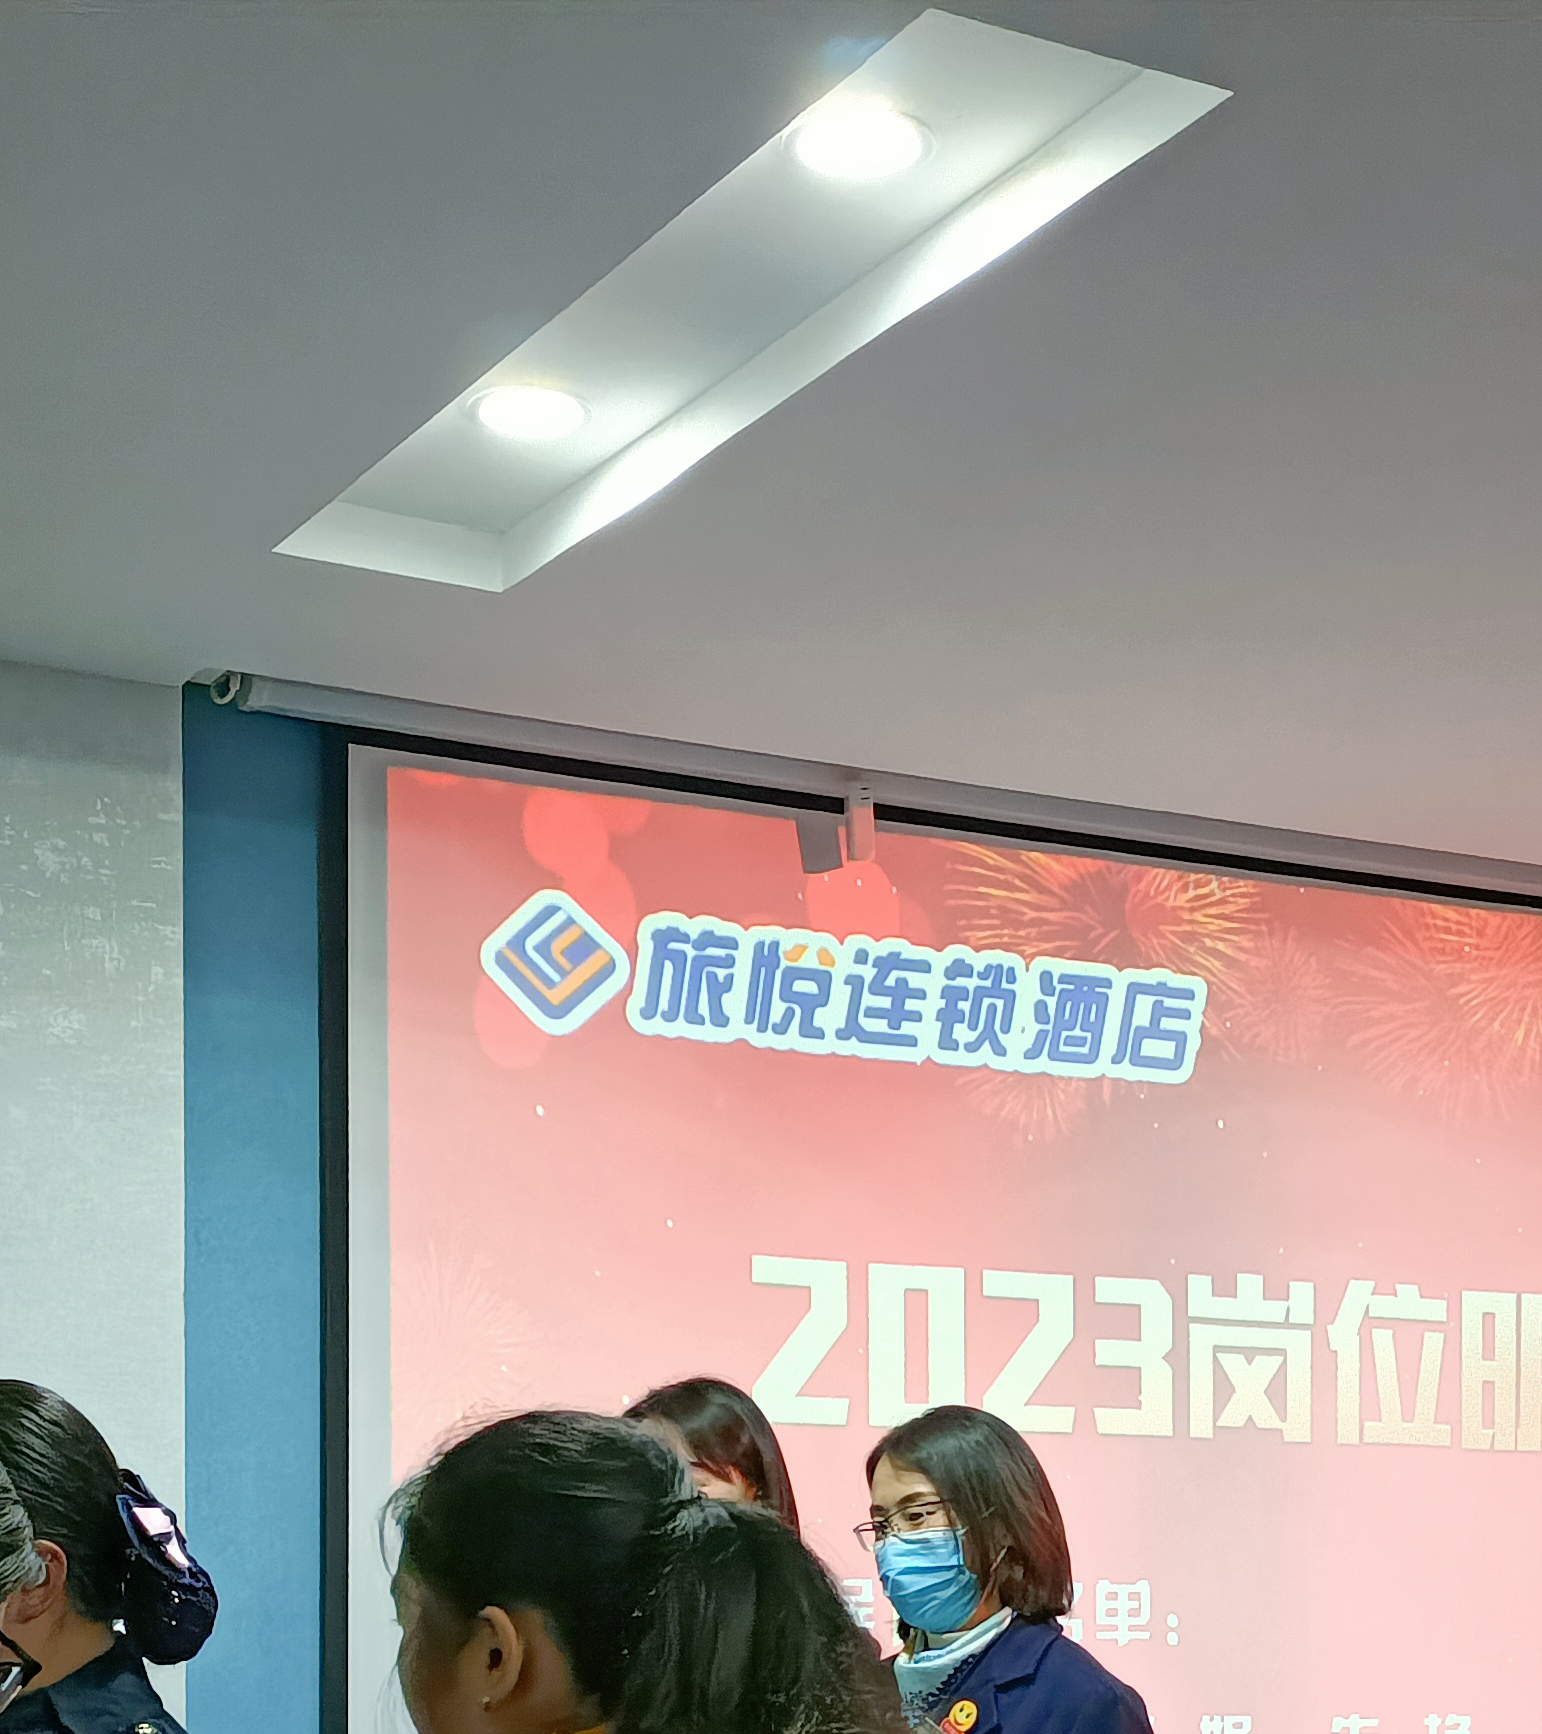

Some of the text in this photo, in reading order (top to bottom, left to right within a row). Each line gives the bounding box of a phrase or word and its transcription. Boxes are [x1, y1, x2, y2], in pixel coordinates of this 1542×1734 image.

[639, 923, 1197, 1073] 旅悦连锁酒店
